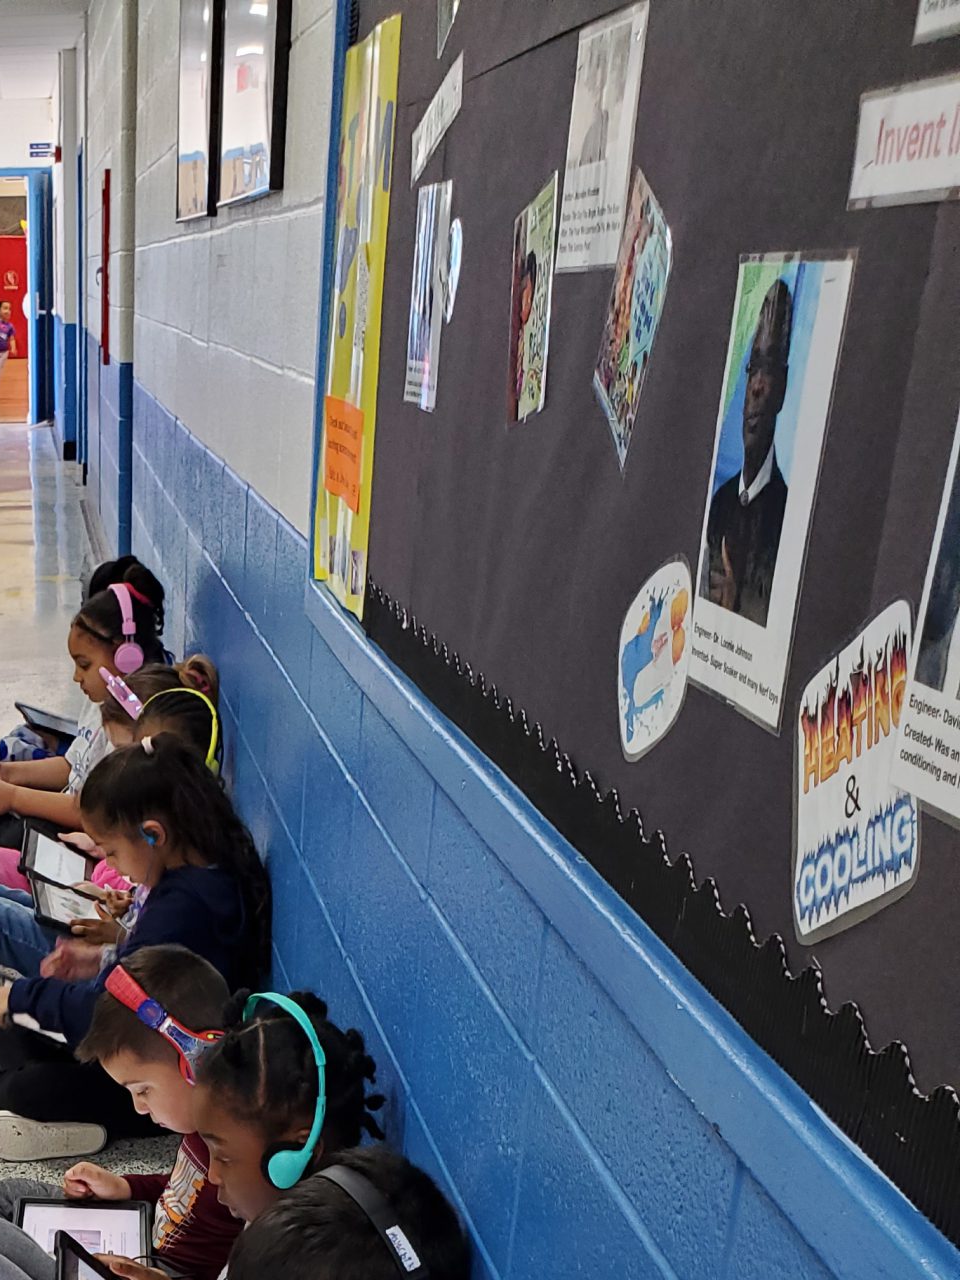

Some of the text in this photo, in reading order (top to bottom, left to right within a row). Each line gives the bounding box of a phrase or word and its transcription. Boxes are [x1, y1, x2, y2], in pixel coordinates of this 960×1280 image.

[875, 112, 947, 166] Invent
[735, 644, 752, 661] Johnson
[710, 654, 723, 670] Super
[723, 662, 738, 678] Soaker
[739, 671, 747, 684] and
[747, 677, 758, 694] many
[759, 682, 769, 697] Nerf
[801, 632, 908, 795] HEATING
[909, 693, 942, 719] Engineer-
[904, 723, 960, 763] Created- Was an
[900, 748, 956, 787] conditioning and
[844, 773, 862, 819] &
[797, 798, 916, 914] COOLING
